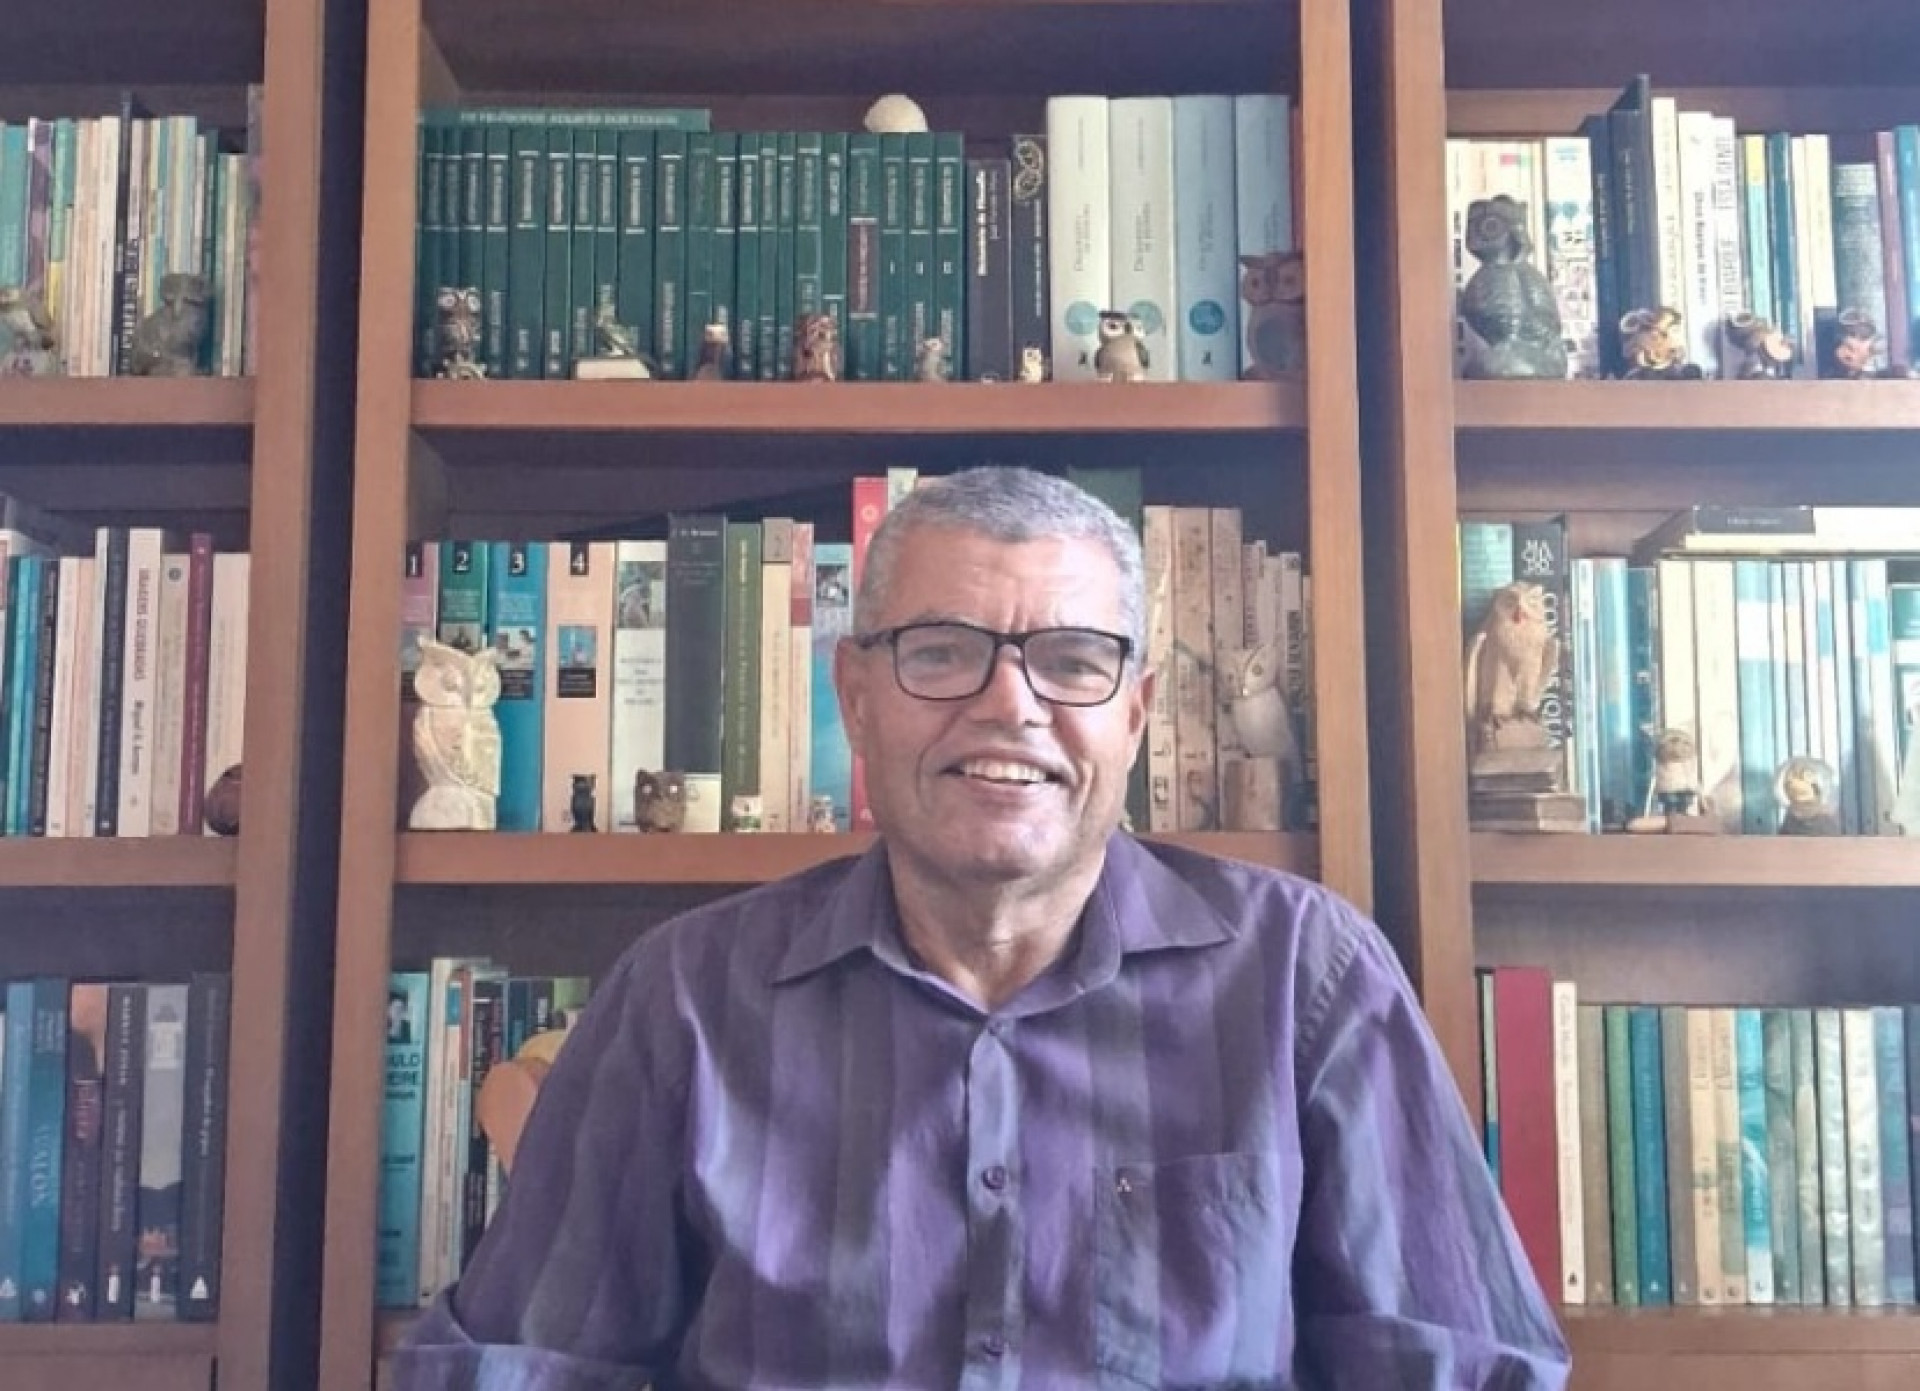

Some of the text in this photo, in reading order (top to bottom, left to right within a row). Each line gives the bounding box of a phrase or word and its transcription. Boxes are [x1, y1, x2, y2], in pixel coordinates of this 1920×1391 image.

[409, 554, 417, 576] 1
[456, 551, 469, 571] 2
[511, 551, 525, 574] 3
[572, 551, 585, 573] 4
